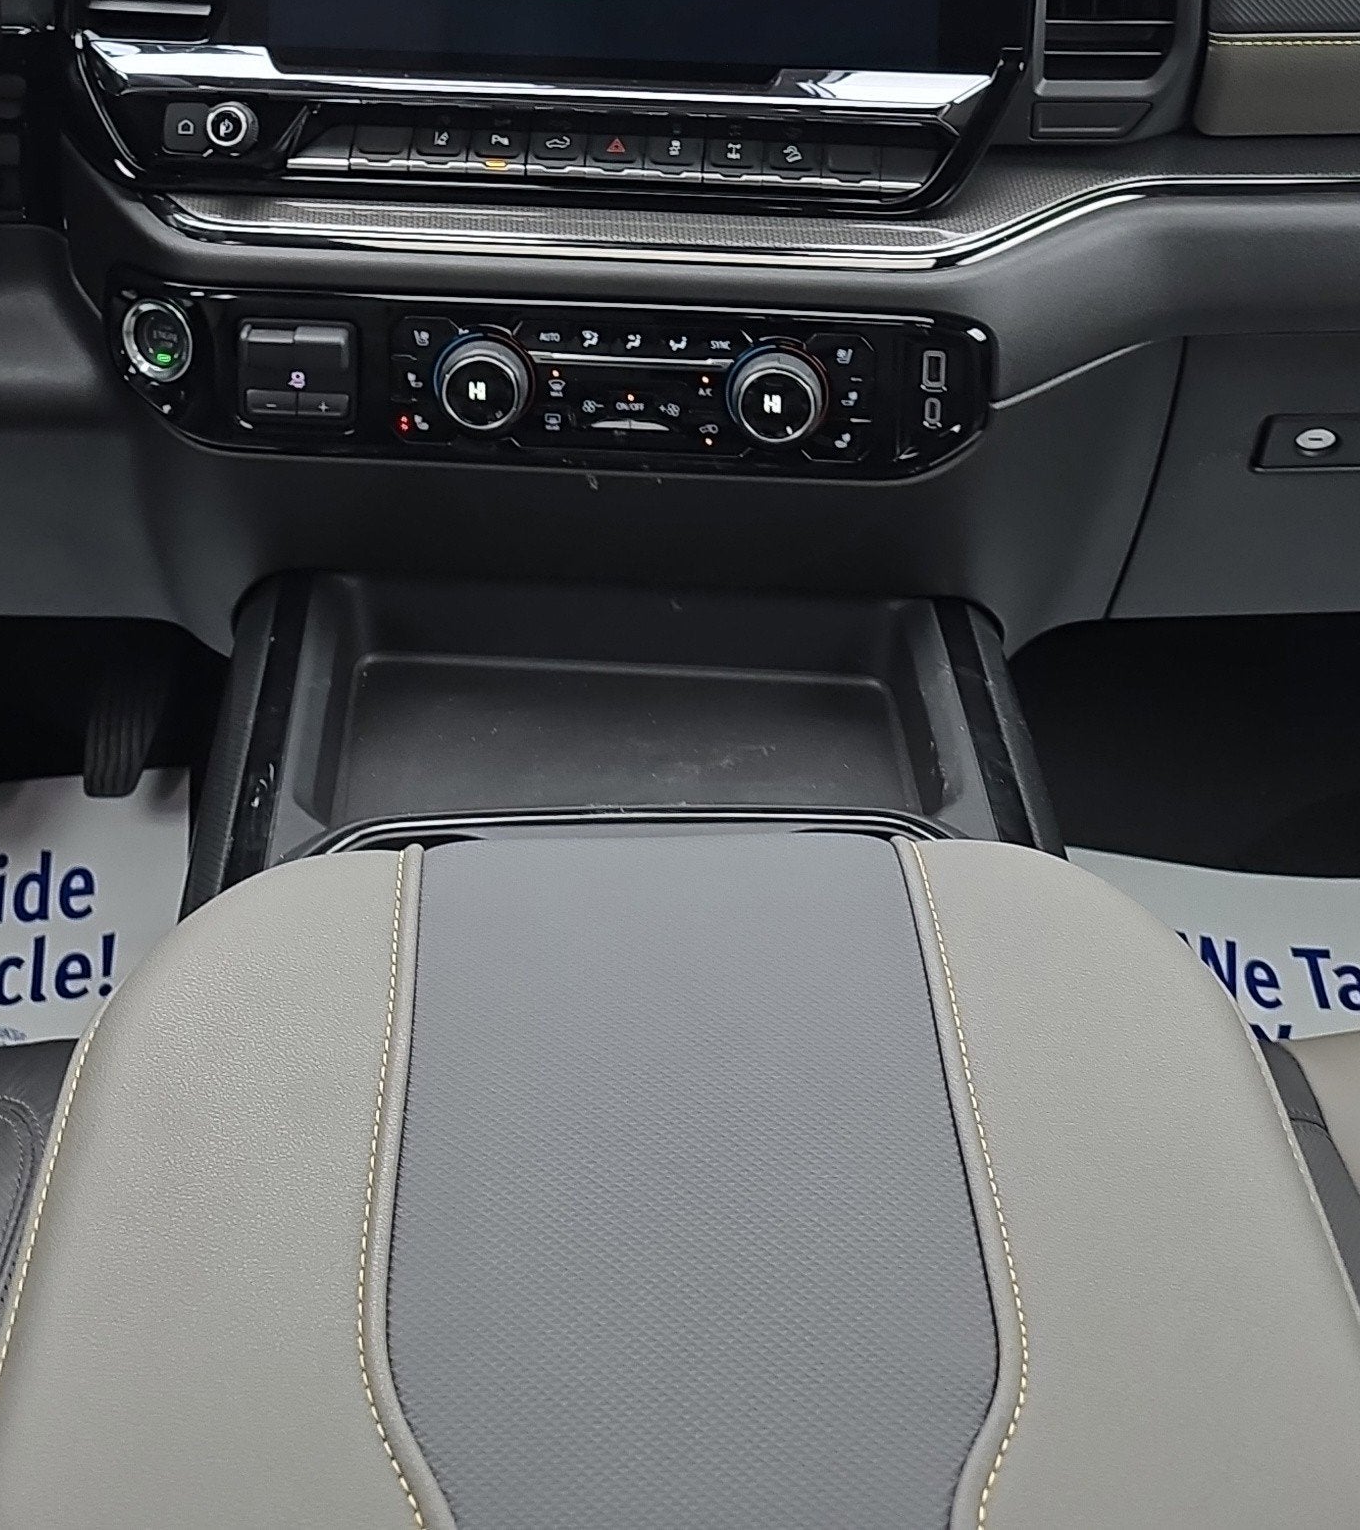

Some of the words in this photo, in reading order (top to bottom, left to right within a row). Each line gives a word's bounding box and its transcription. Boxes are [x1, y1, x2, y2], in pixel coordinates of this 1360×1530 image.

[539, 332, 561, 342] AUTO
[710, 340, 732, 350] SYNC
[1175, 929, 1282, 1011] We
